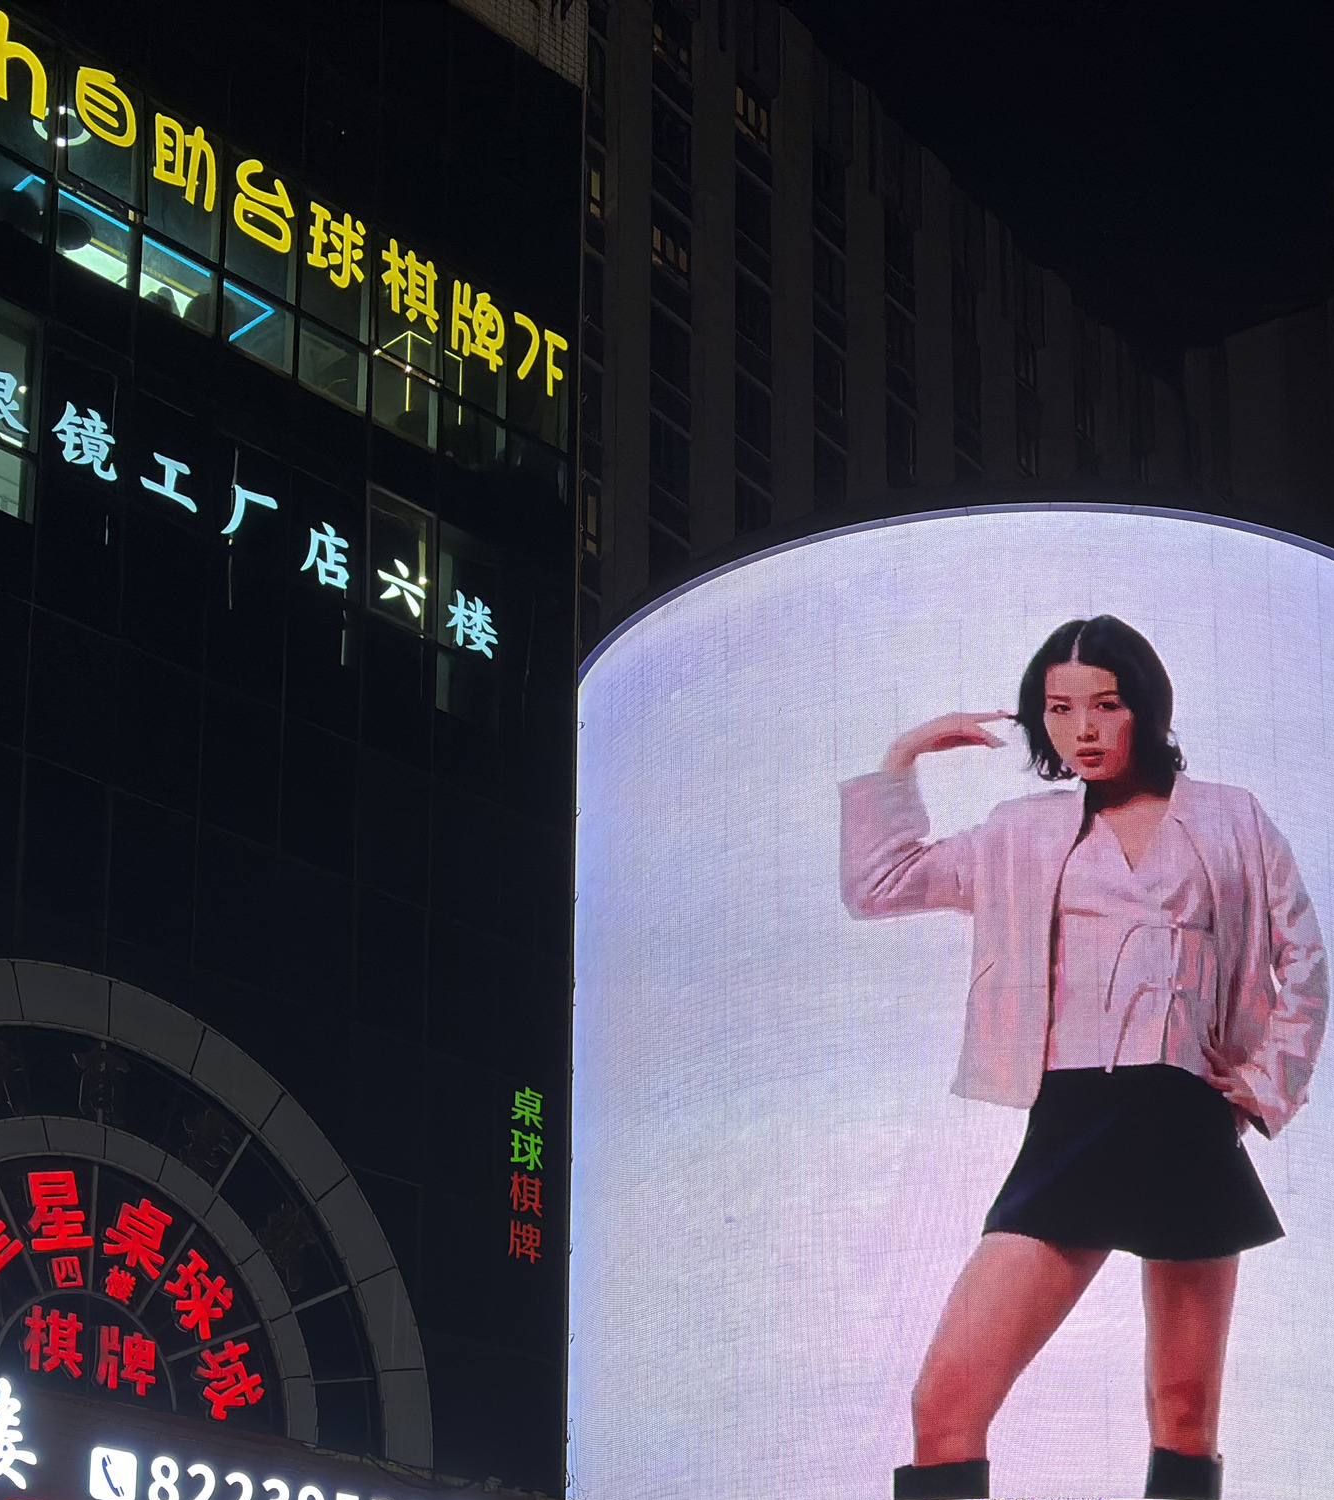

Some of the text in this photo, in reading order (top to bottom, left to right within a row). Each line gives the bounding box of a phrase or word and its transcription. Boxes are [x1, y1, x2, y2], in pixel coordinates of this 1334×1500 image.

[507, 1085, 545, 1265] 桌球棋牌
[52, 1255, 137, 1304] 四楼
[24, 1304, 156, 1398] 棋牌
